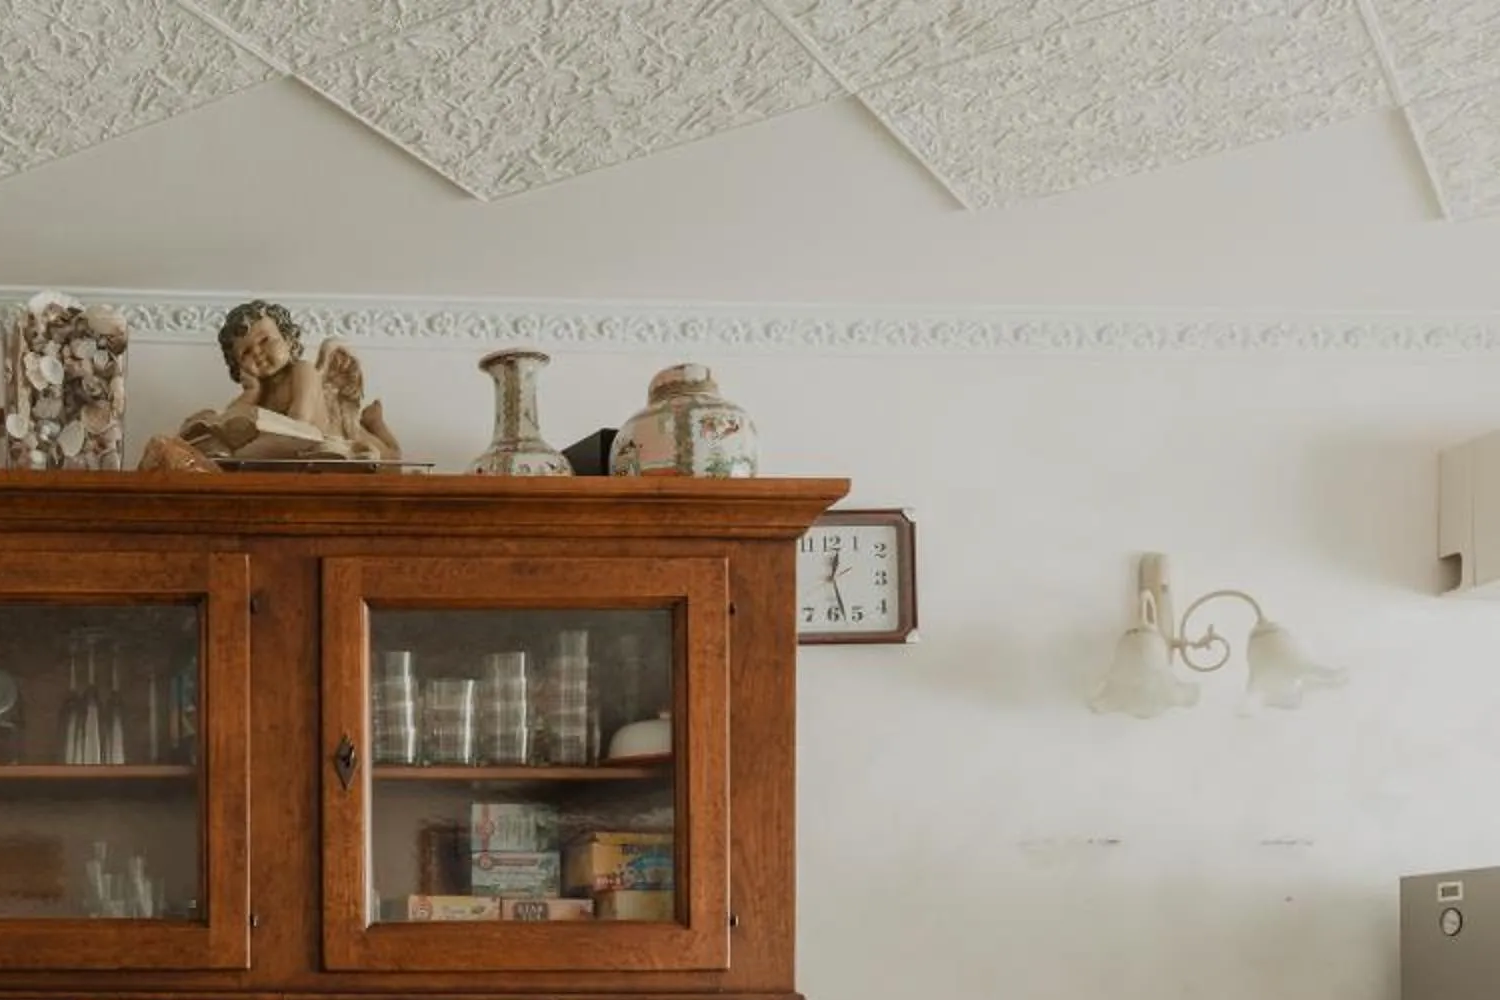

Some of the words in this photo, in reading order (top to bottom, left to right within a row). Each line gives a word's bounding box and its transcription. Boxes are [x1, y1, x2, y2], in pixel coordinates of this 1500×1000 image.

[801, 536, 813, 552] 11
[823, 536, 841, 552] 12
[852, 536, 858, 551] 1
[874, 543, 887, 559] 2
[874, 570, 888, 586] 3
[803, 607, 815, 622] 7
[827, 605, 840, 621] 6
[851, 605, 864, 621] 5
[875, 599, 887, 614] 4
